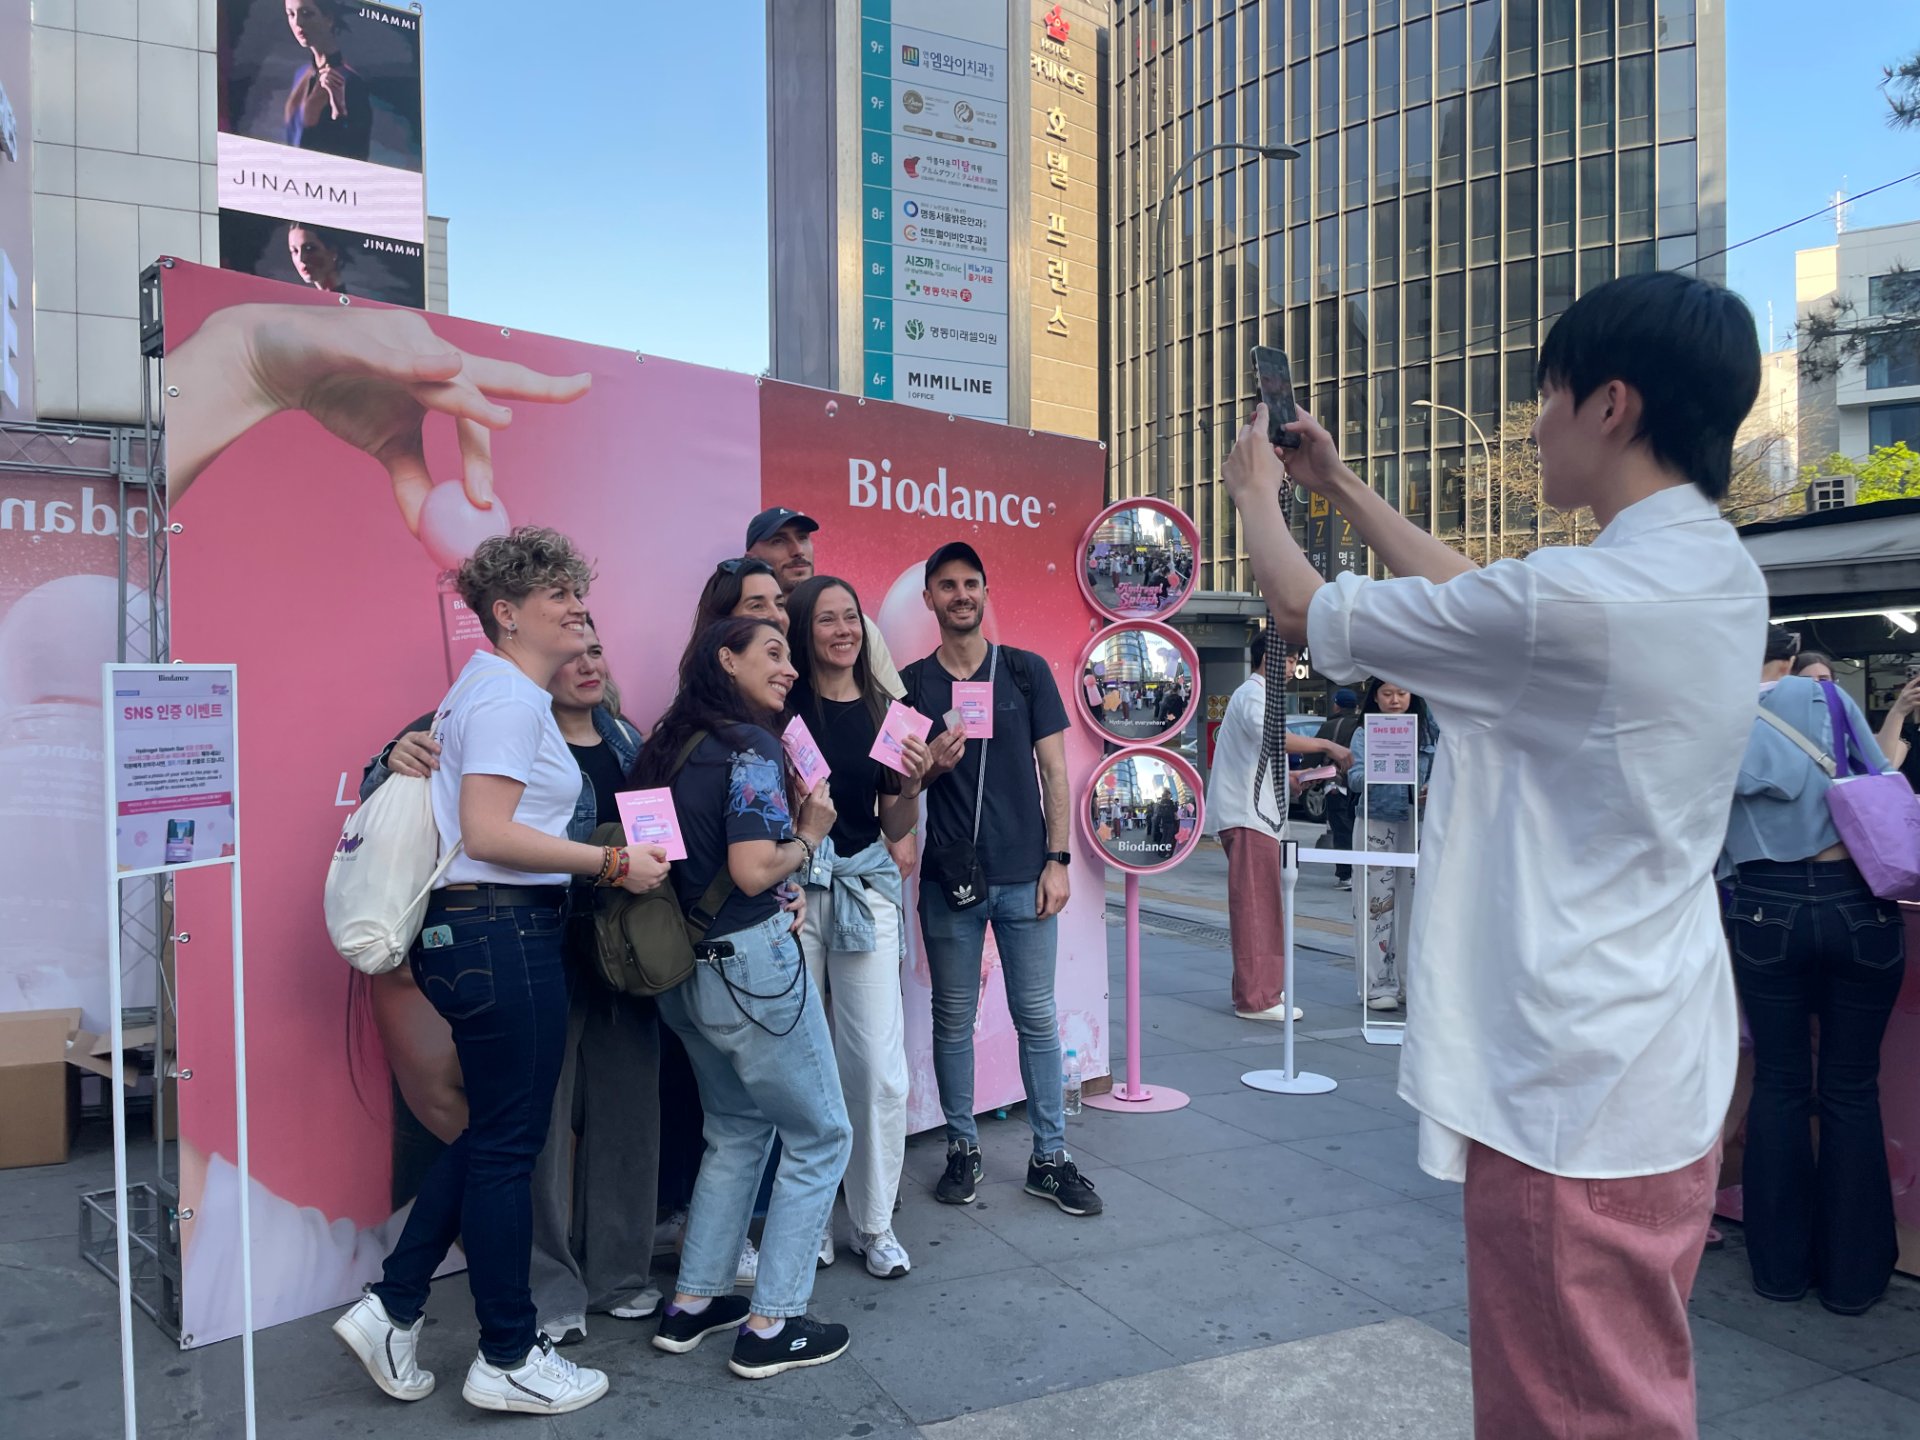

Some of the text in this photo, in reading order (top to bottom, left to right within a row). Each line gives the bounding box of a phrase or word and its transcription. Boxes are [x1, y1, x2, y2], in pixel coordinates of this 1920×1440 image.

[359, 8, 416, 31] JINAMMI
[871, 41, 884, 54] 9F
[1041, 38, 1071, 59] HOTEL
[871, 96, 885, 110] 9F
[871, 152, 885, 165] 8F
[233, 170, 357, 206] JINAMMI
[871, 208, 885, 221] 8F
[363, 239, 420, 257] JINAMMI
[872, 263, 885, 276] 8F
[941, 263, 962, 273] Clinic
[872, 318, 886, 331] 7F
[930, 326, 997, 346] 명동미래셀의원
[873, 373, 886, 386] 6F
[908, 372, 992, 394] MIMILINE
[912, 391, 935, 401] OFFICE
[848, 457, 1042, 529] Biodance
[1316, 521, 1324, 537] 7
[158, 674, 190, 682] Biodance
[124, 703, 223, 721] SNS 인증 이벤트
[1118, 841, 1172, 851] Biodance
